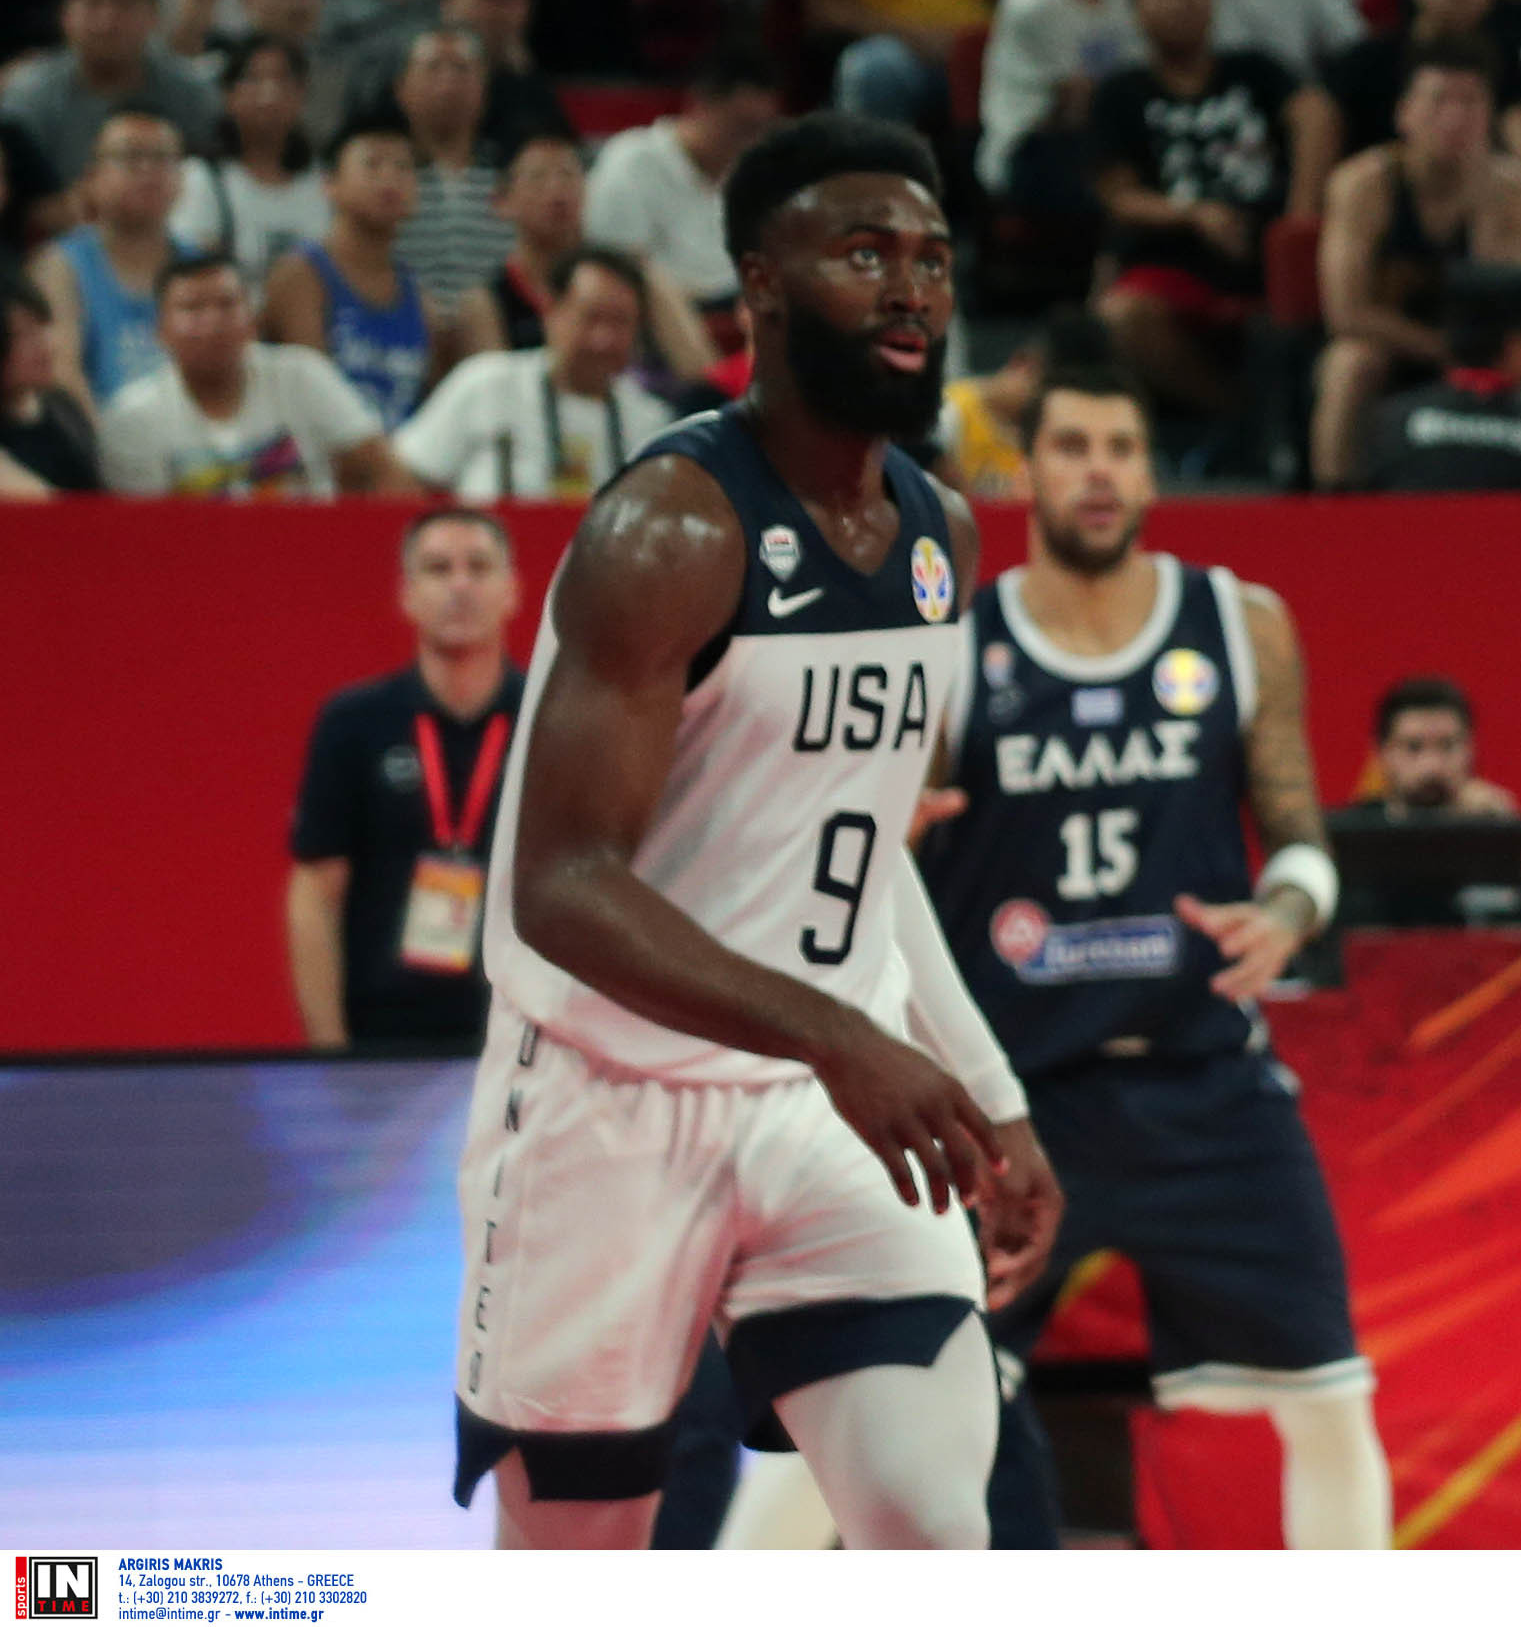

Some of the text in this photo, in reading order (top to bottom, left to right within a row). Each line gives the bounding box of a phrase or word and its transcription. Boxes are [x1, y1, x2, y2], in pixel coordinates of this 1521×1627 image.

[792, 662, 928, 753] USA
[800, 810, 877, 967] 9
[1056, 808, 1140, 902] 15
